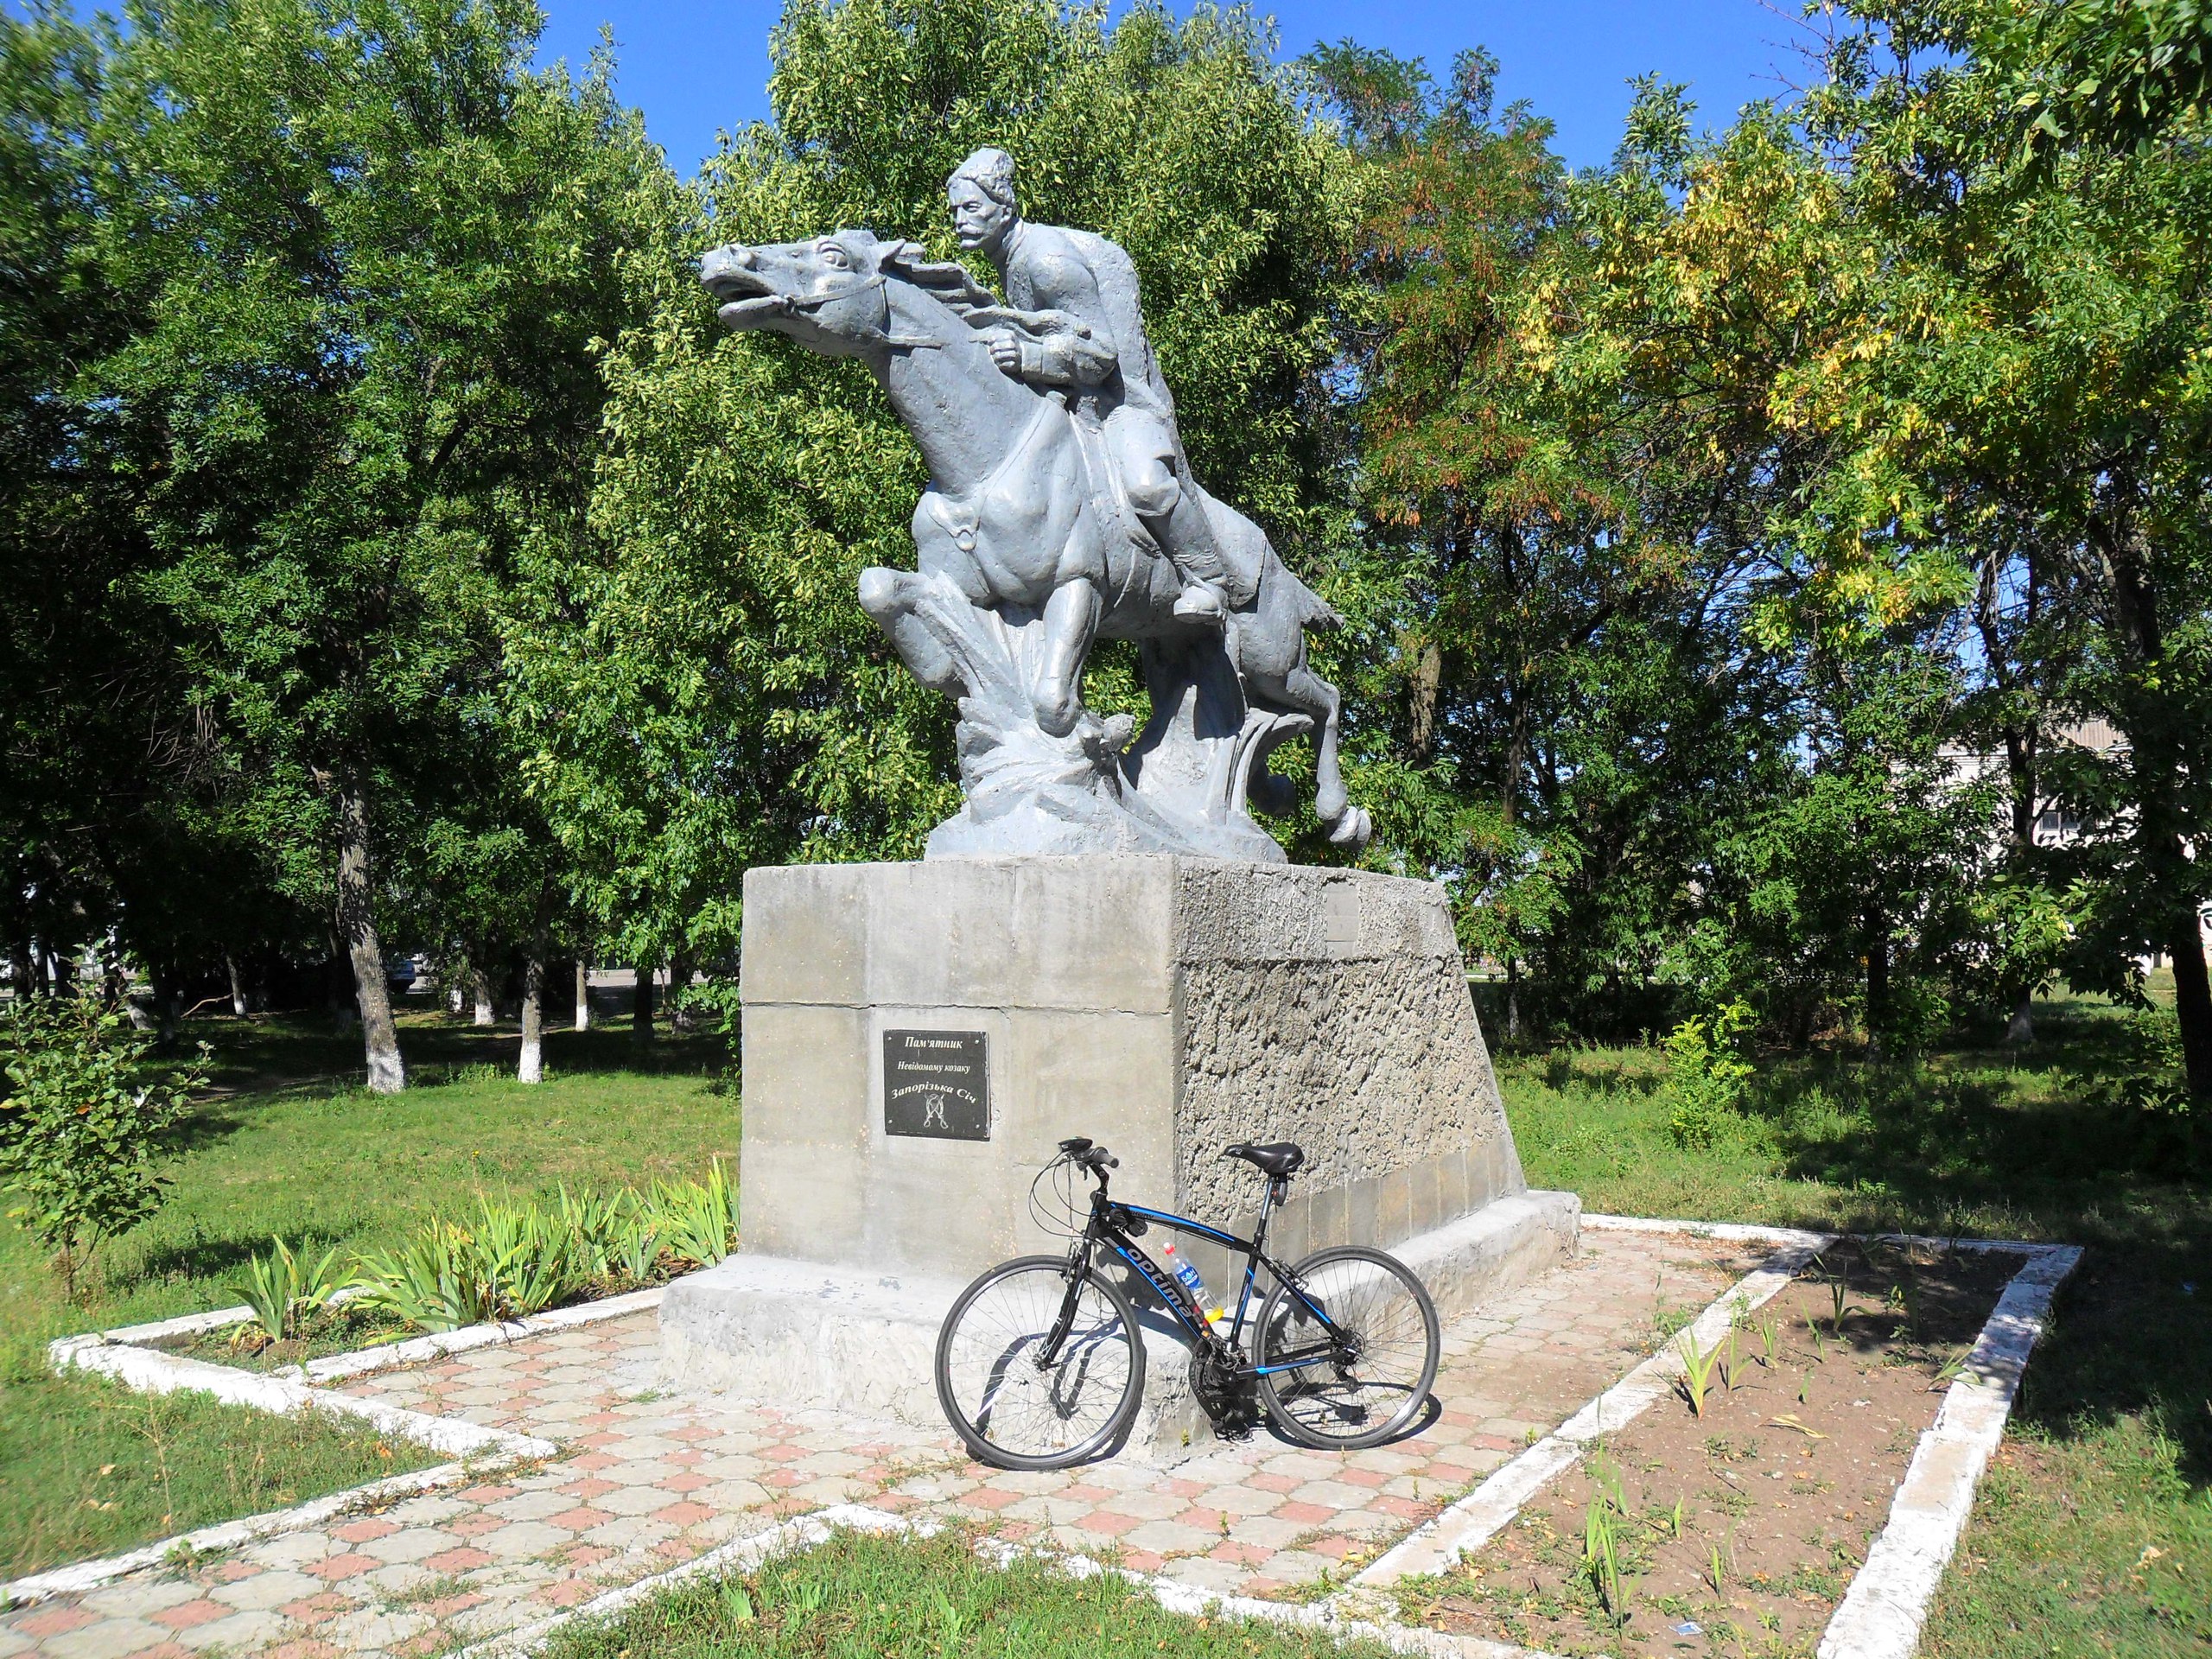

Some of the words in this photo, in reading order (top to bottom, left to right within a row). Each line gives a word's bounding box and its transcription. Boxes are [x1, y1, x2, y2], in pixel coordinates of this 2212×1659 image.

[897, 1061, 944, 1073] Невідомому
[944, 1065, 971, 1074] козаку
[891, 1081, 955, 1100] Запорізька
[957, 1088, 976, 1104] Січ
